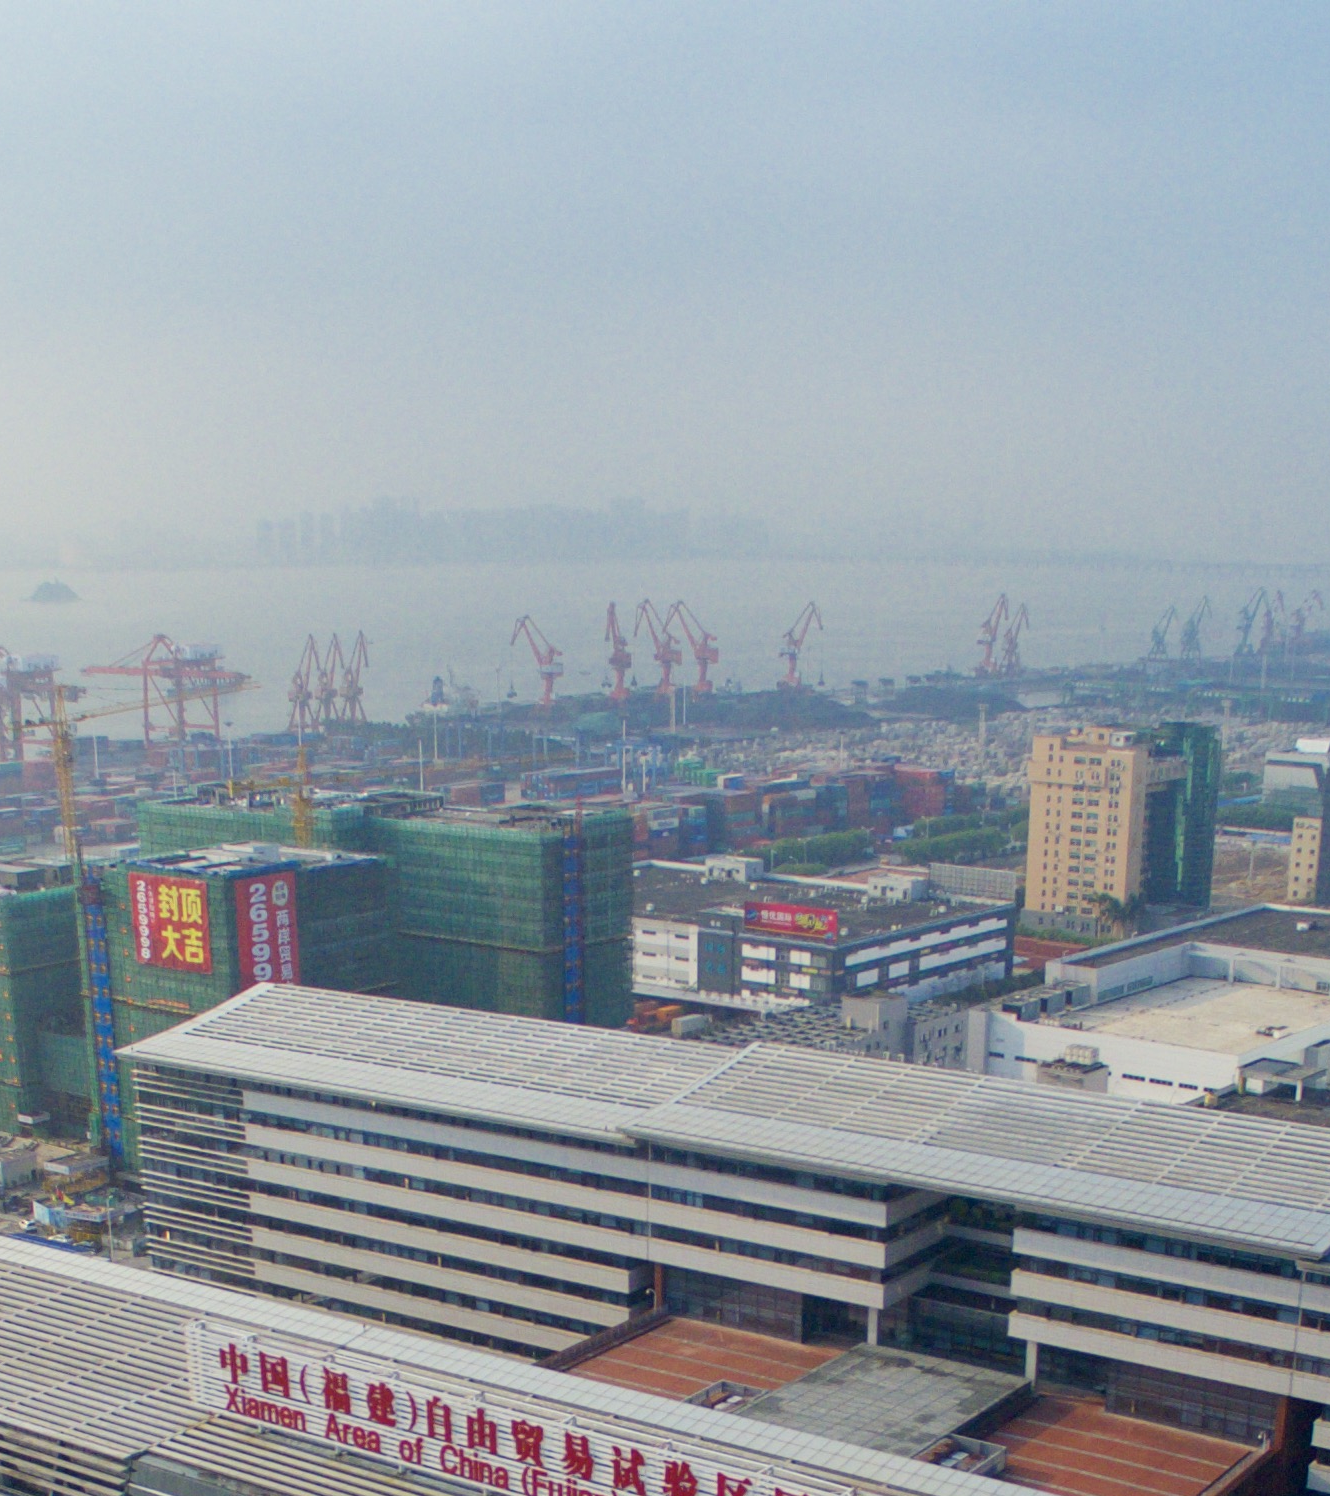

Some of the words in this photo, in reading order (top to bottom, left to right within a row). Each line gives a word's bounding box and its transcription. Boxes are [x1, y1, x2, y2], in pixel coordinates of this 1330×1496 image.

[158, 884, 202, 925] 封顶
[161, 925, 204, 964] 大吉
[225, 1384, 306, 1432] Xiamen
[324, 1413, 381, 1453] Area
[399, 1437, 423, 1465] of
[439, 1444, 509, 1490] China
